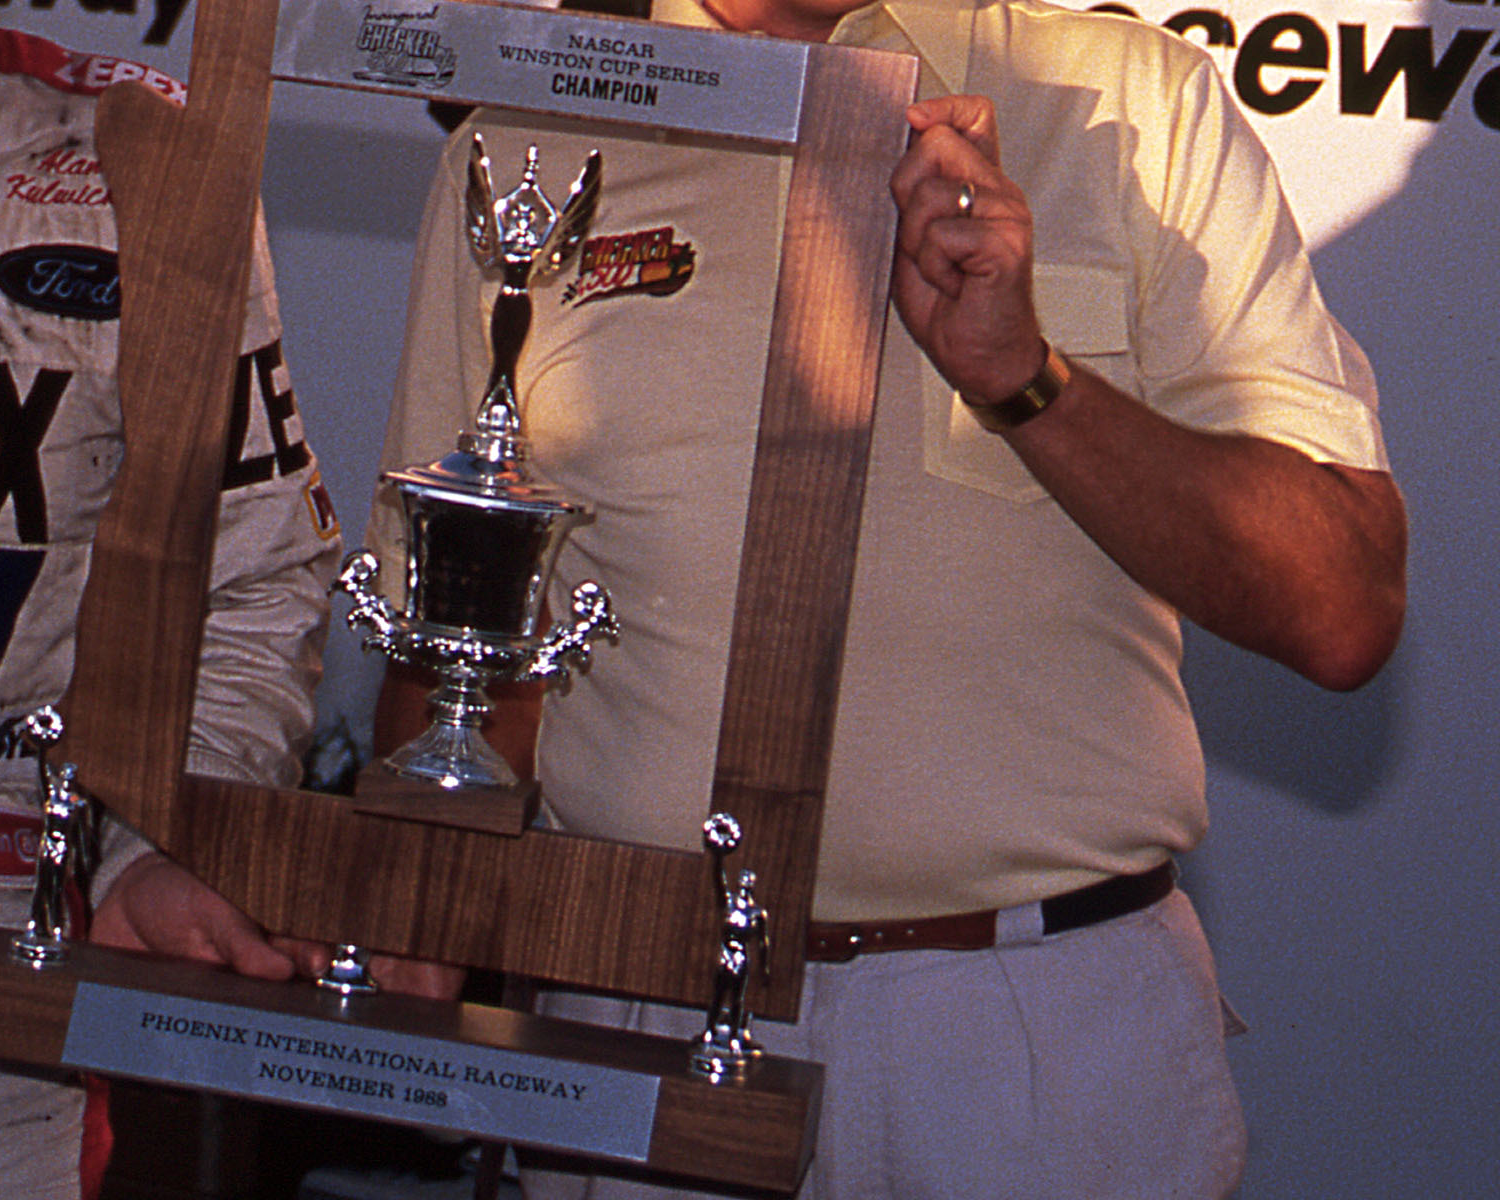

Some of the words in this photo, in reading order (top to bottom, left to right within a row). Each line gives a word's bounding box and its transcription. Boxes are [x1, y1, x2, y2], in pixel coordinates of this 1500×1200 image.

[357, 23, 441, 59] CHECKER
[567, 34, 655, 59] NASCAR
[498, 44, 594, 71] WINSTON
[599, 57, 641, 77] CUP
[645, 64, 720, 87] SERIES
[551, 72, 658, 107] CHAMPION
[6, 173, 112, 206] Kulwic
[27, 258, 120, 305] Ford
[140, 1011, 248, 1047] PHOENIX
[254, 1030, 457, 1080] INTERNATIONAL
[463, 1065, 588, 1101] RACEWAY
[257, 1060, 396, 1099] NOVEMBER
[402, 1086, 449, 1109] 1988
